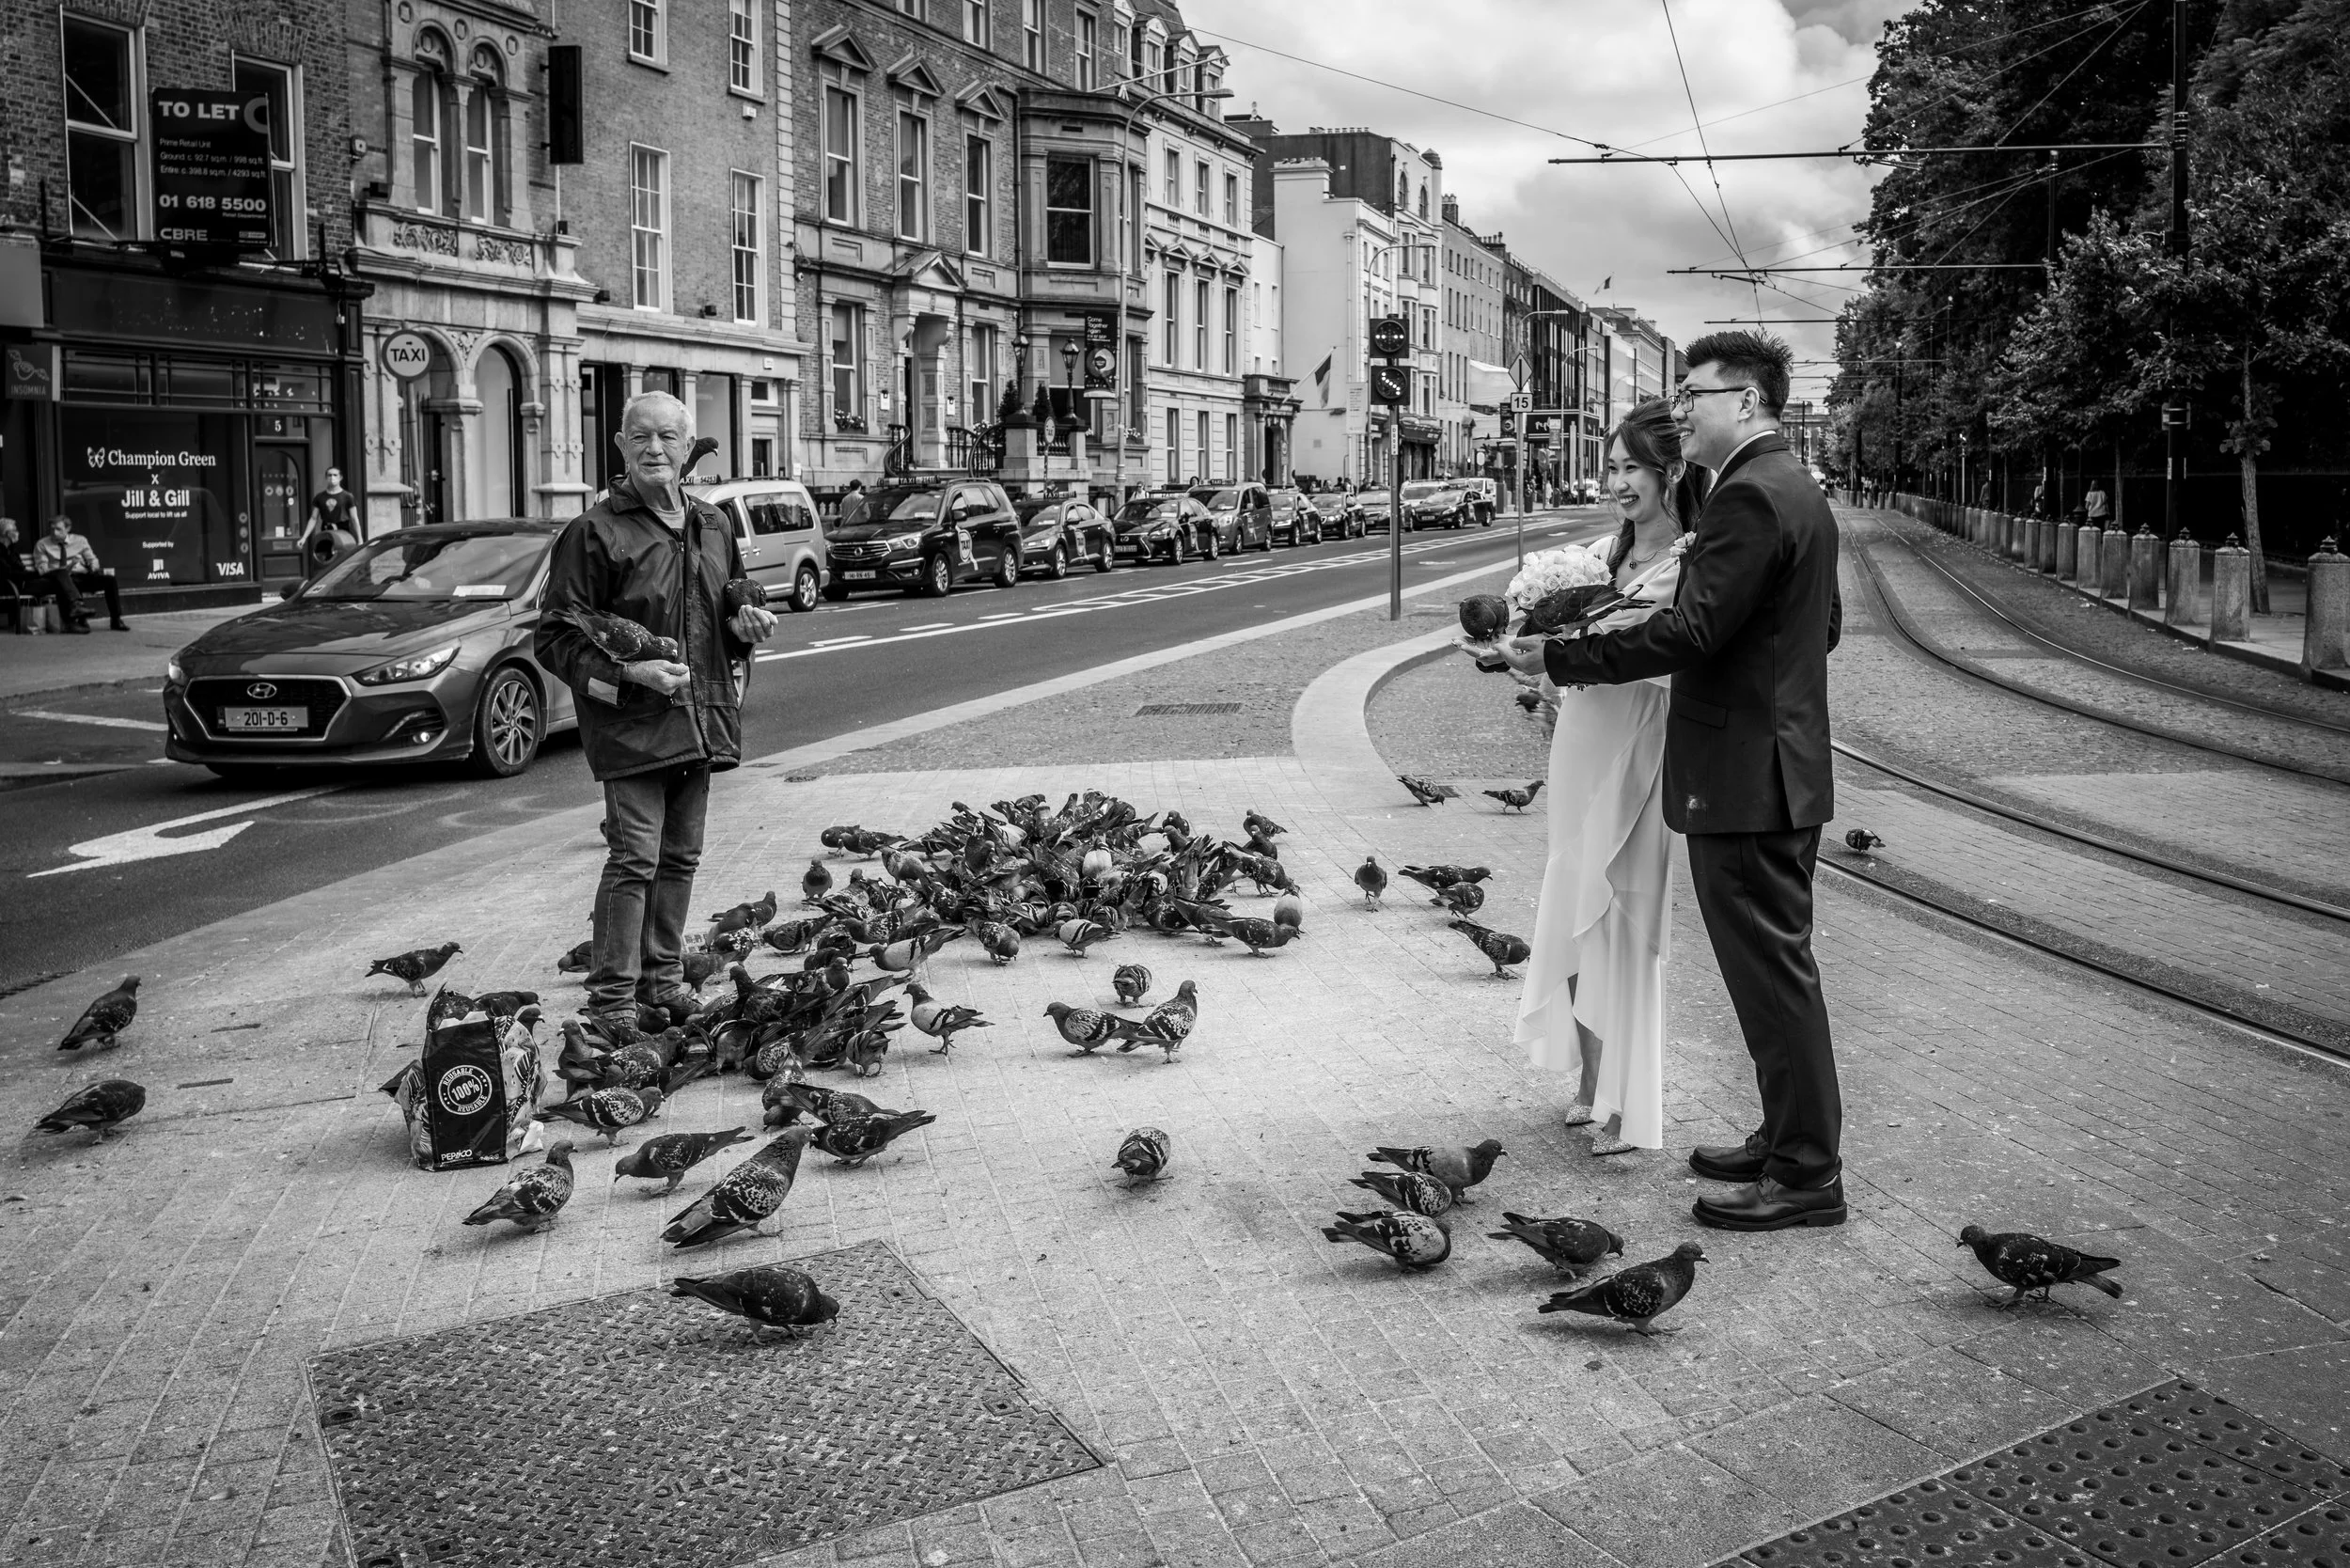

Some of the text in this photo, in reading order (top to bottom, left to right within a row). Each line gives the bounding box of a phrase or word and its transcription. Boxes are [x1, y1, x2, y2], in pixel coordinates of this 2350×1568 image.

[158, 101, 240, 120] TO LET
[159, 194, 266, 212] 01 618 5500
[160, 227, 208, 241] CBRE
[390, 349, 425, 362] TAXI
[10, 384, 46, 395] INSOMNIA
[1514, 397, 1528, 409] 15
[274, 420, 281, 431] 5
[108, 449, 216, 469] Champion Green
[680, 476, 694, 484] AXI
[121, 490, 190, 508] Jill & Gill
[125, 510, 146, 520] Support
[142, 541, 167, 549] Supported
[148, 572, 170, 580] AVIVA
[216, 562, 244, 576] VISA
[244, 712, 288, 726] 201-D-6
[443, 1068, 473, 1086] REUSABLE
[451, 1078, 479, 1101] 100%
[457, 1095, 487, 1112] REUSABLE
